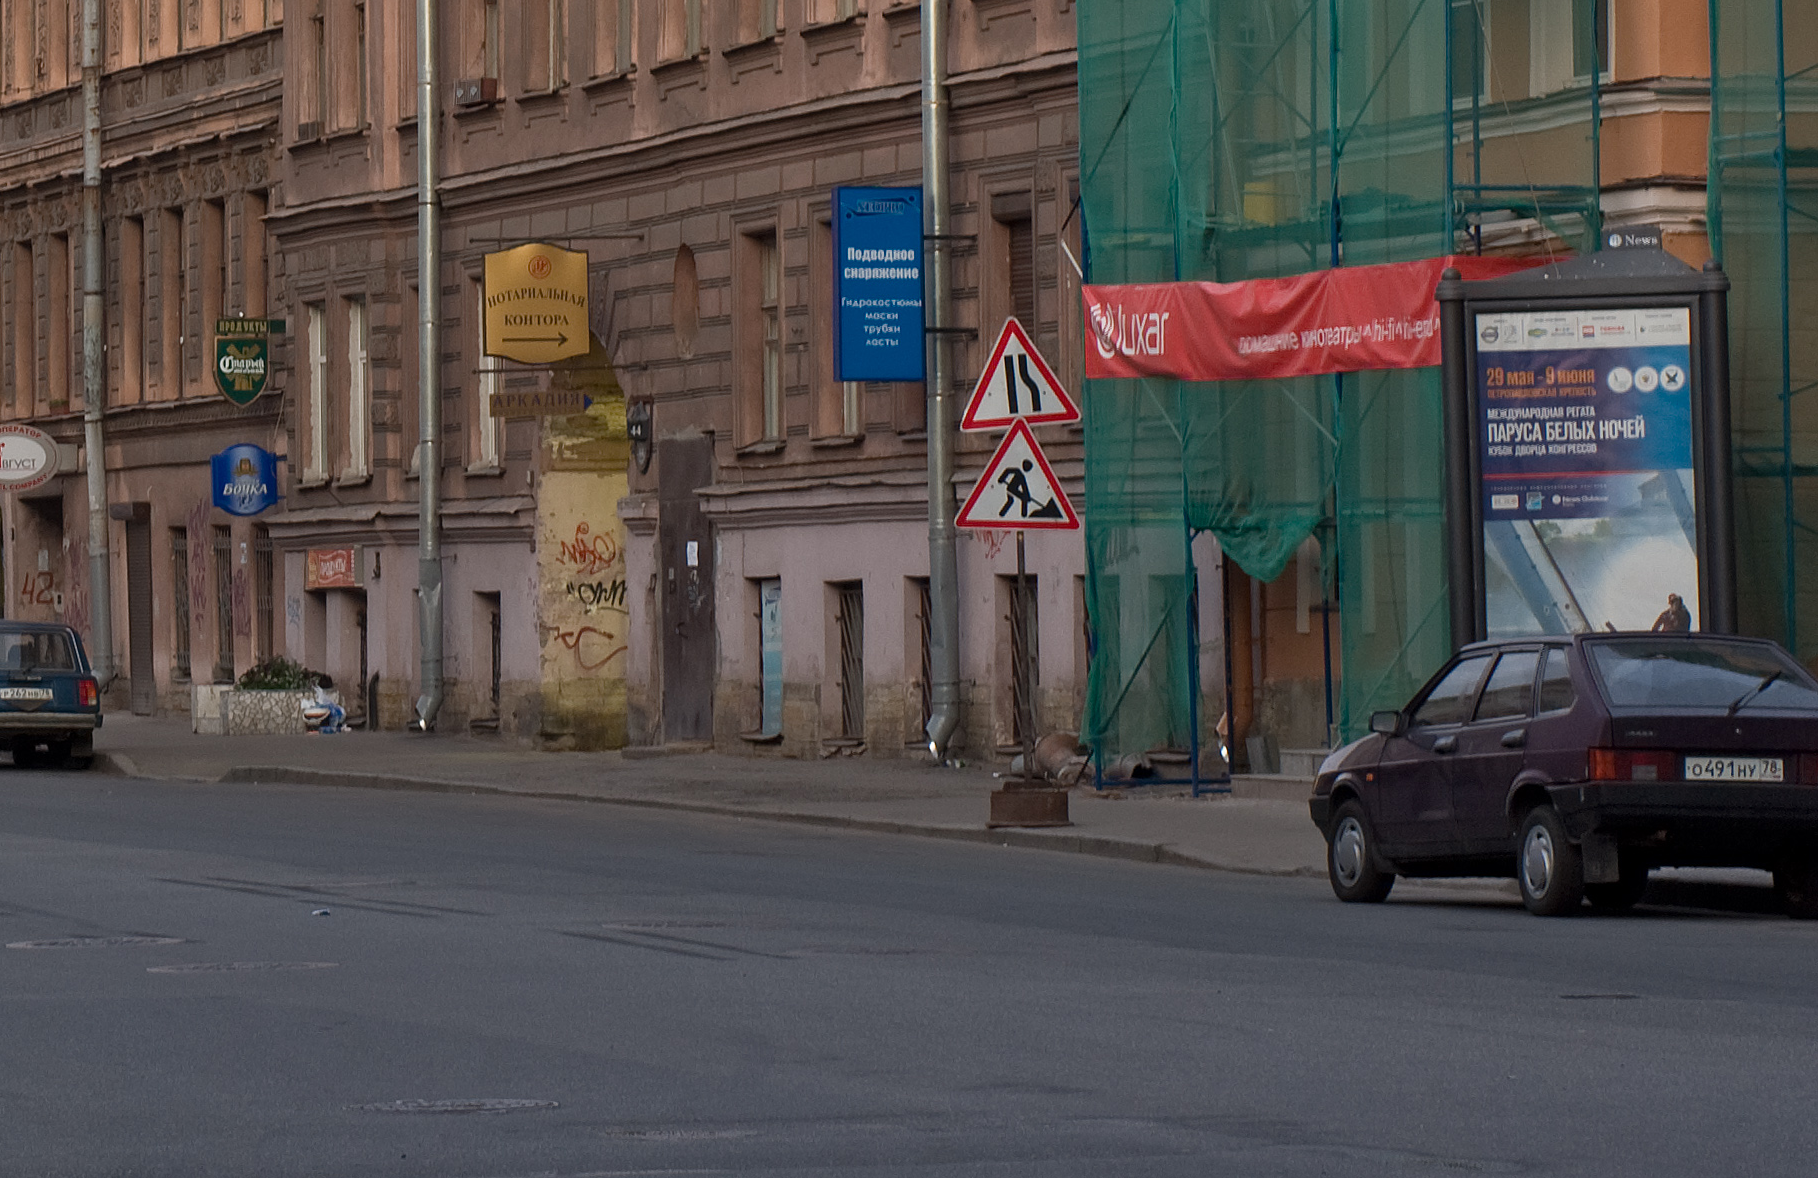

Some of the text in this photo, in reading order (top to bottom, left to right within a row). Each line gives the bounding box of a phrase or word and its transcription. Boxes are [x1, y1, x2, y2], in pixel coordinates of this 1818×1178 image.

[1625, 233, 1658, 247] News
[847, 247, 916, 263] Подводное
[843, 266, 920, 281] снаряжение
[487, 287, 586, 310] НОТАРИАЛЬНАЯ
[841, 296, 922, 309] Гидрокостюмы
[503, 313, 570, 327] КОНТОРА
[865, 312, 899, 320] маски
[219, 320, 268, 333] ПРОДУКТЫ
[863, 323, 901, 334] трубки
[865, 338, 899, 346] ласты
[1486, 366, 1504, 386] 29
[1506, 370, 1535, 386] мая
[1545, 365, 1555, 385] 9
[1557, 369, 1595, 385] июня
[492, 392, 581, 409] АРКАДИЯ
[1487, 405, 1596, 421] МЕЖДУНАРОДНАЯ РЕГАТА
[1488, 414, 1646, 444] ПАРУСА БЕЛЫХ НОЧЕЙ
[1515, 443, 1547, 457] ДВОРЦА
[21, 571, 55, 606] 42
